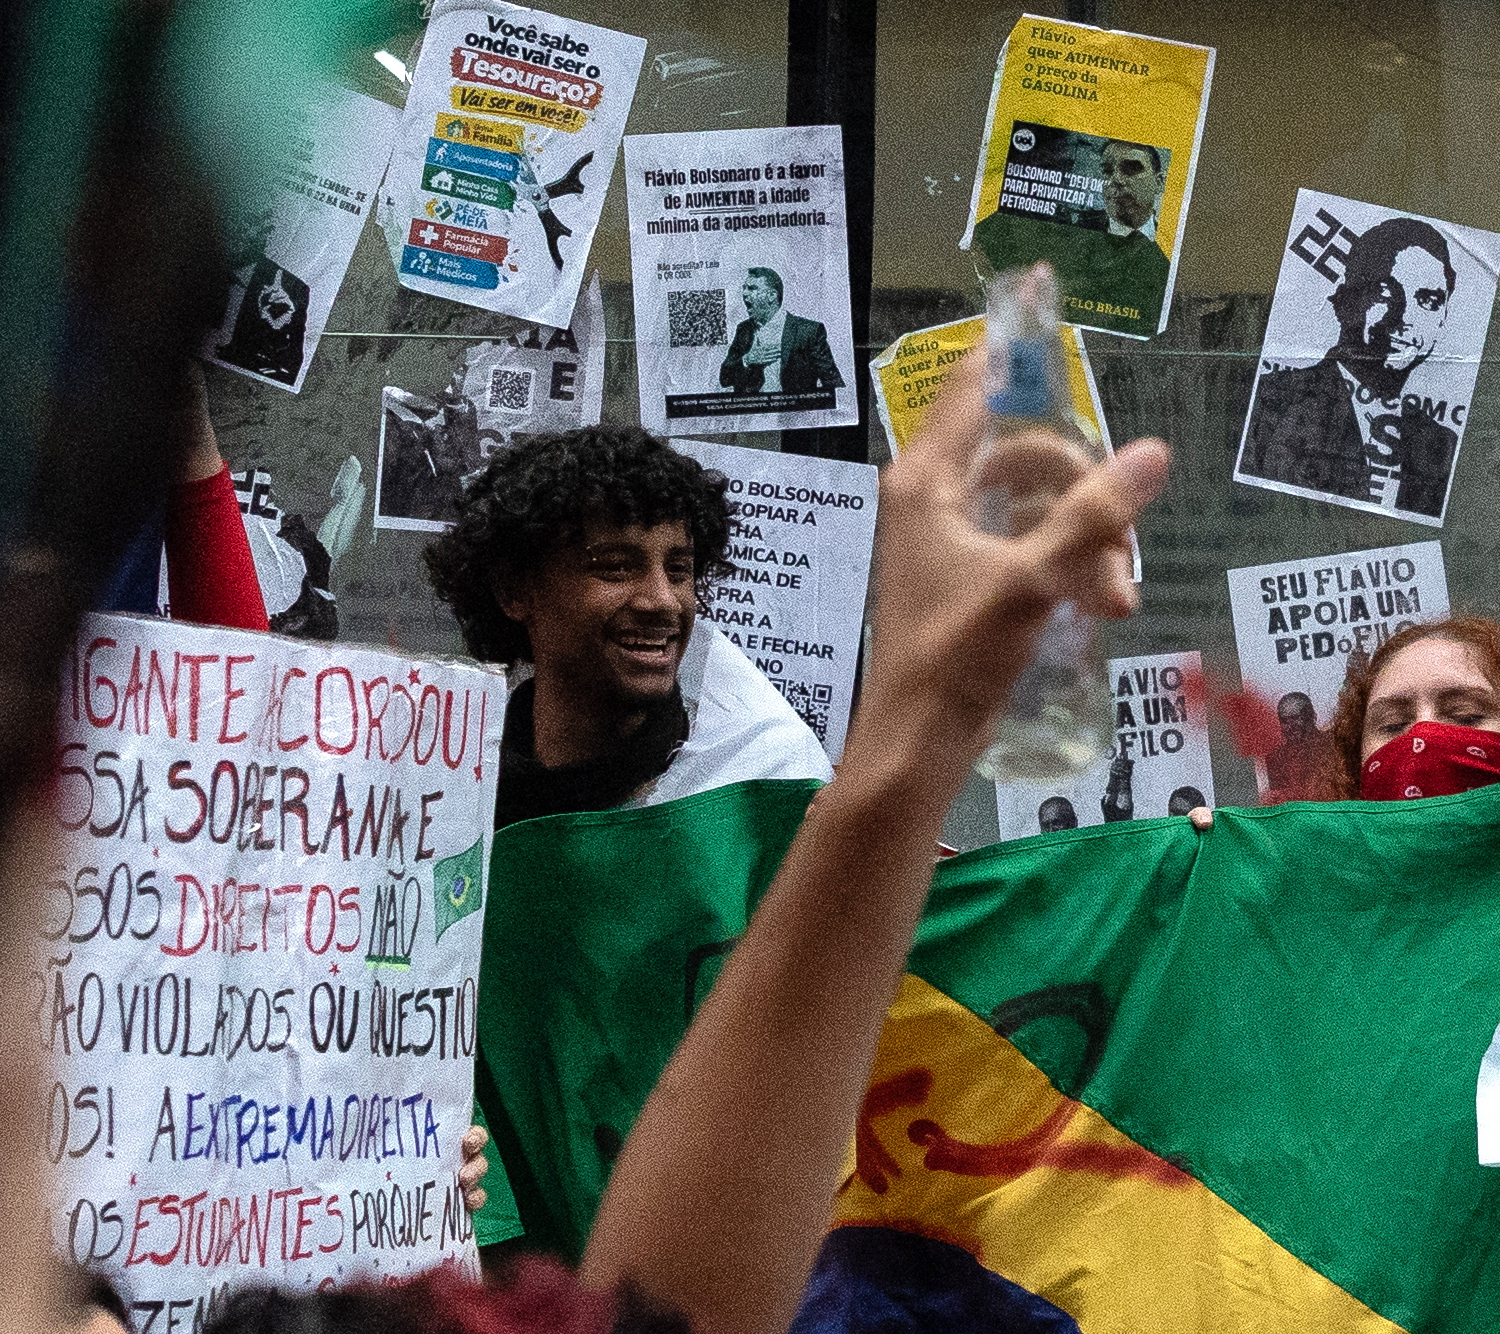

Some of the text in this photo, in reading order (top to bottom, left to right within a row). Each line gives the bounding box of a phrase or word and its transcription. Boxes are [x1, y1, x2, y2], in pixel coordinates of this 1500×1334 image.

[487, 15, 589, 57] Você sabe
[1031, 26, 1077, 45] Flávio
[465, 33, 600, 79] onde vai ser o
[1027, 45, 1150, 76] quer AUMENTAR
[460, 51, 596, 104] Tesouraço?
[1025, 63, 1098, 84] o preço da
[1021, 77, 1099, 102] GASOLINA
[460, 88, 578, 126] Vai ser em você!
[473, 132, 513, 147] Família
[644, 163, 826, 187] Flávio Bolsonaro é a favor
[1007, 162, 1062, 184] BOLSONARO
[664, 187, 810, 210] de AUMENTAR a idade
[1004, 178, 1094, 206] PARA PRIVATIZAR A
[1001, 193, 1056, 215] PETROBRAS
[453, 213, 488, 230] MEIA
[647, 210, 830, 235] mínima da aposentadoria.
[444, 230, 489, 246] Farmácia
[444, 240, 481, 255] Popular
[436, 266, 477, 282] Médicos
[439, 257, 461, 268] Mais
[1095, 302, 1141, 319] BRASIL
[898, 360, 932, 378] quer
[550, 361, 577, 401] E
[903, 381, 912, 393] o
[748, 482, 863, 510] BOLSONARO
[802, 510, 817, 526] A
[783, 552, 810, 569] DA
[776, 573, 802, 589] DE
[1260, 557, 1416, 604] SEU FLÁVIO
[758, 615, 772, 629] A
[1267, 586, 1422, 635] APOIA UM
[747, 634, 834, 660] E FECHAR
[308, 981, 360, 1055] OU
[149, 1086, 177, 1164] A
[124, 1186, 345, 1268] ESTUDANTES
[350, 1181, 436, 1255] PORQUE
